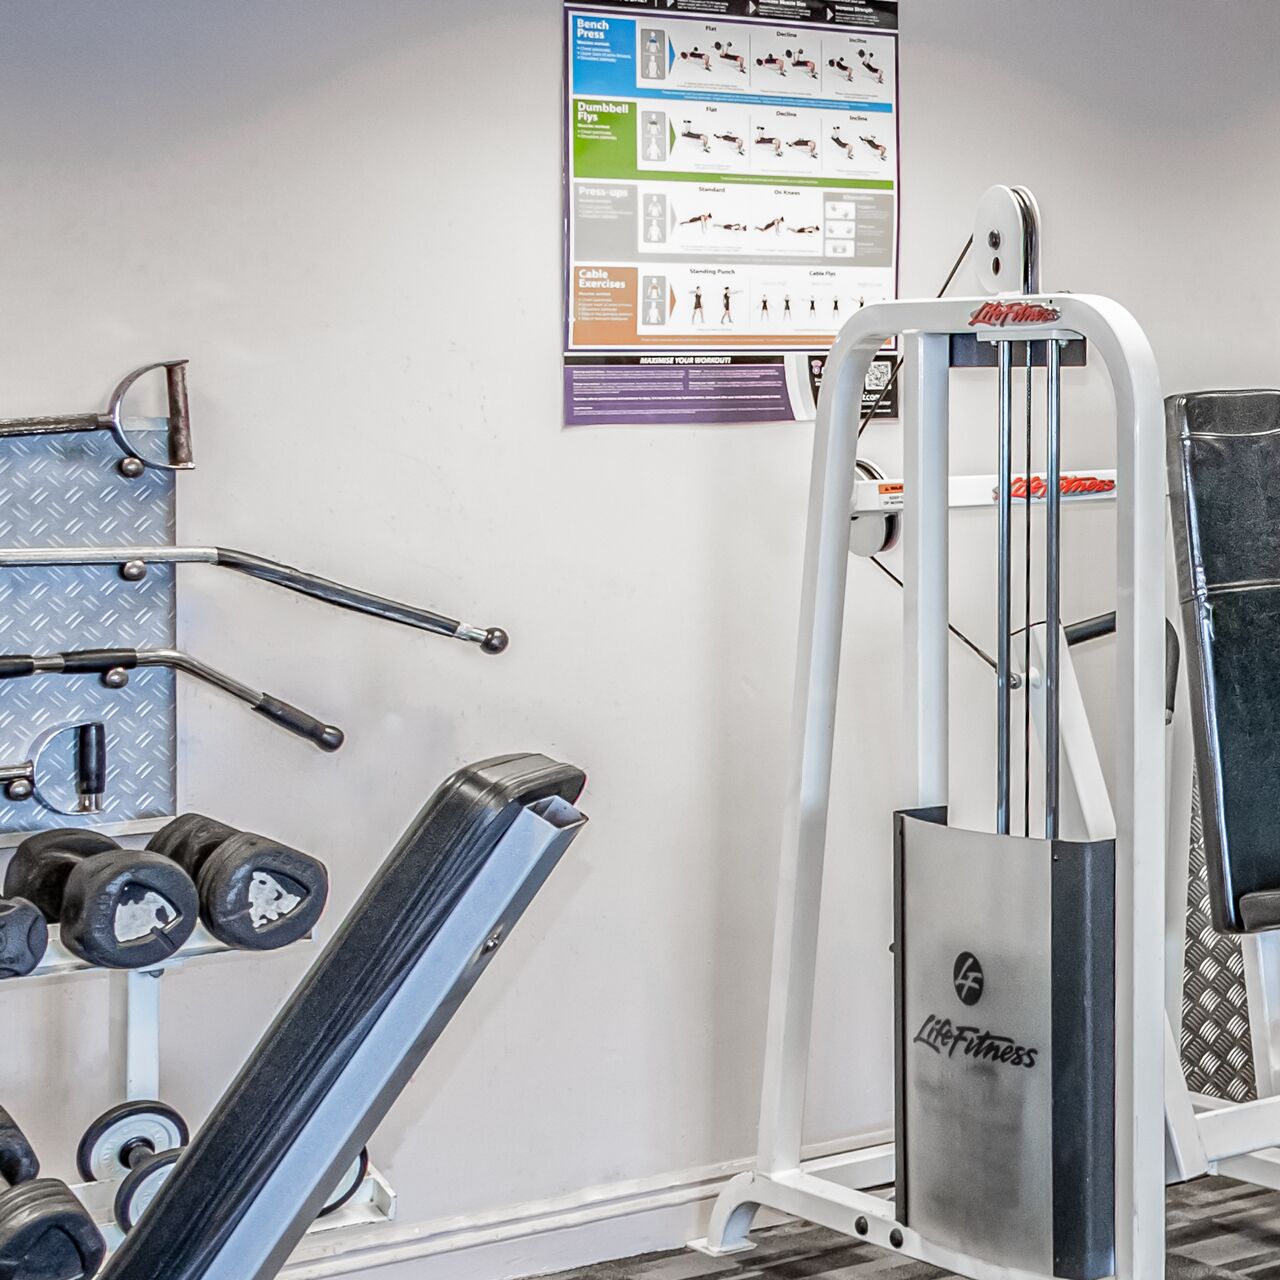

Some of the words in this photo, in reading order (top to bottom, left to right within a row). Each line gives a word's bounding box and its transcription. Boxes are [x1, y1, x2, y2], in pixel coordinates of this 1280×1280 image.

[577, 19, 609, 30] Bench
[577, 28, 604, 39] Press
[578, 102, 628, 114] Dumbbell
[578, 112, 598, 123] Flys
[578, 186, 628, 198] Press-ups
[579, 269, 609, 279] Cable
[579, 278, 626, 289] Exercises
